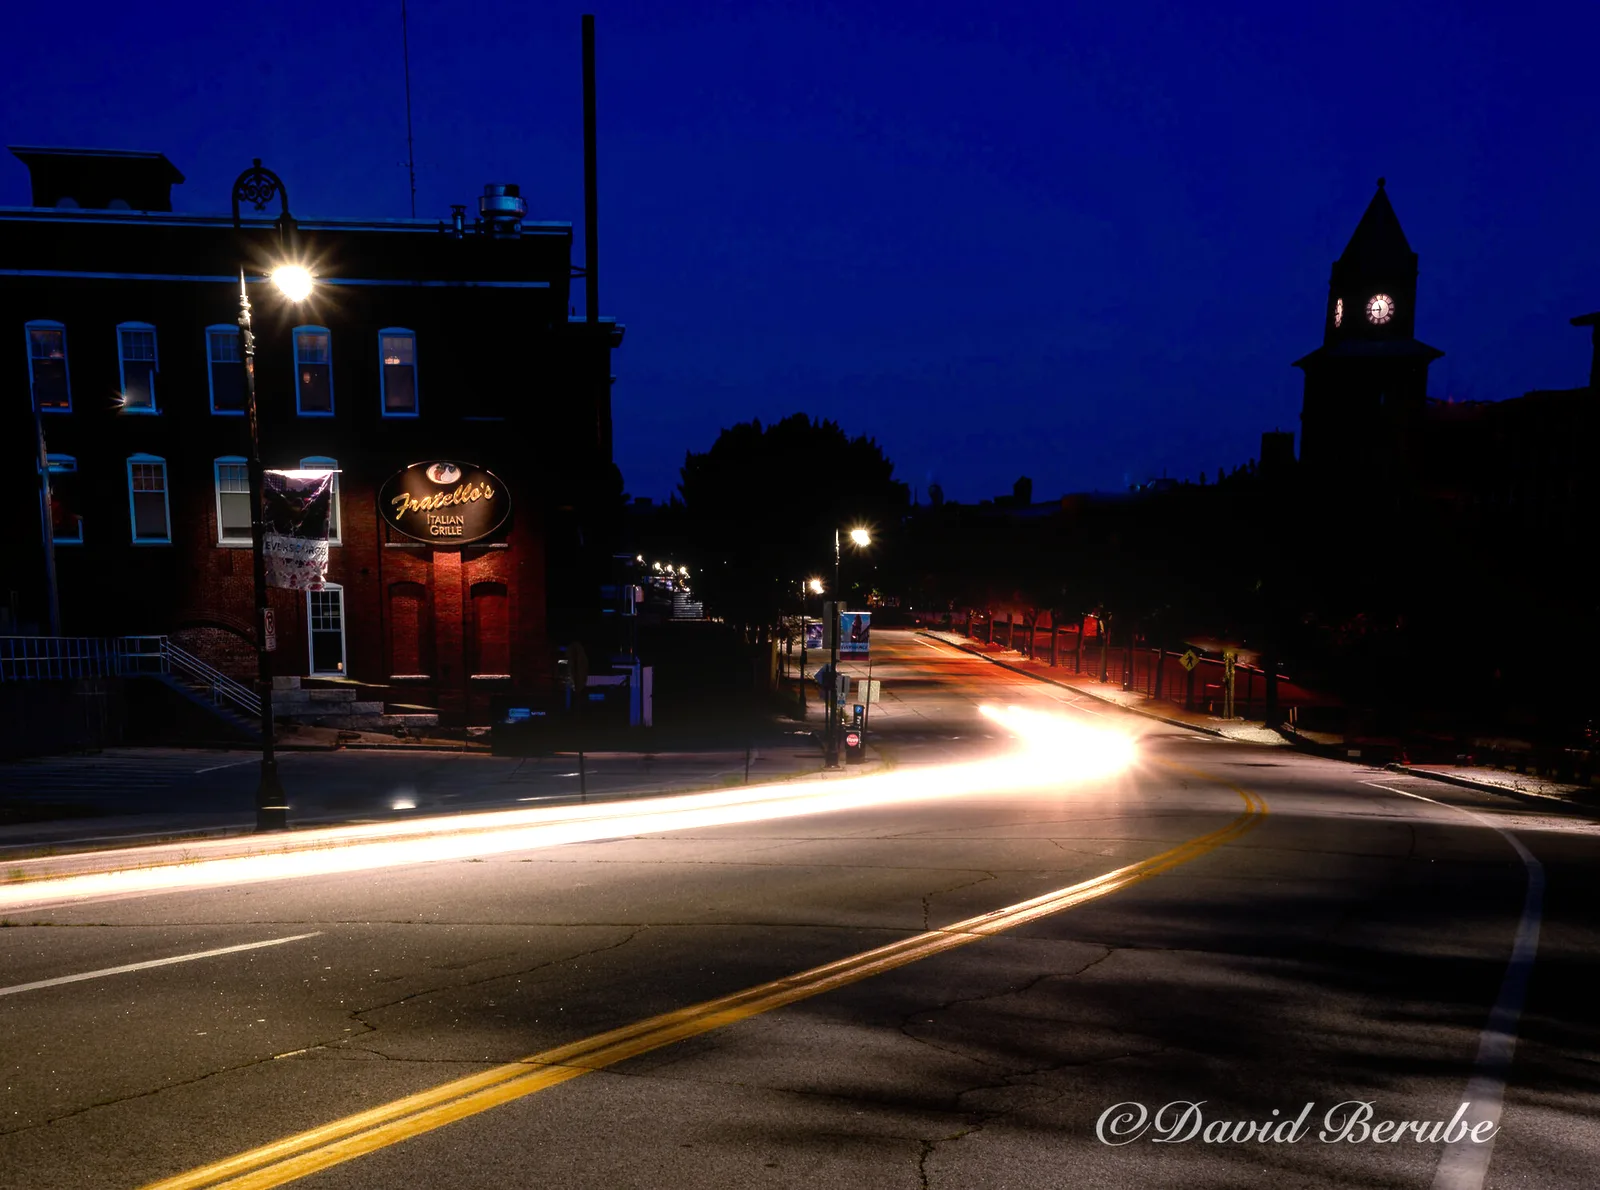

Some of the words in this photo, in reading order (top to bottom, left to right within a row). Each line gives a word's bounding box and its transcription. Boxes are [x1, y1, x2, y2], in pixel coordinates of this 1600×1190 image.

[391, 482, 495, 520] Fratello's
[427, 514, 464, 525] ITALIAN
[430, 525, 462, 536] GRILLE
